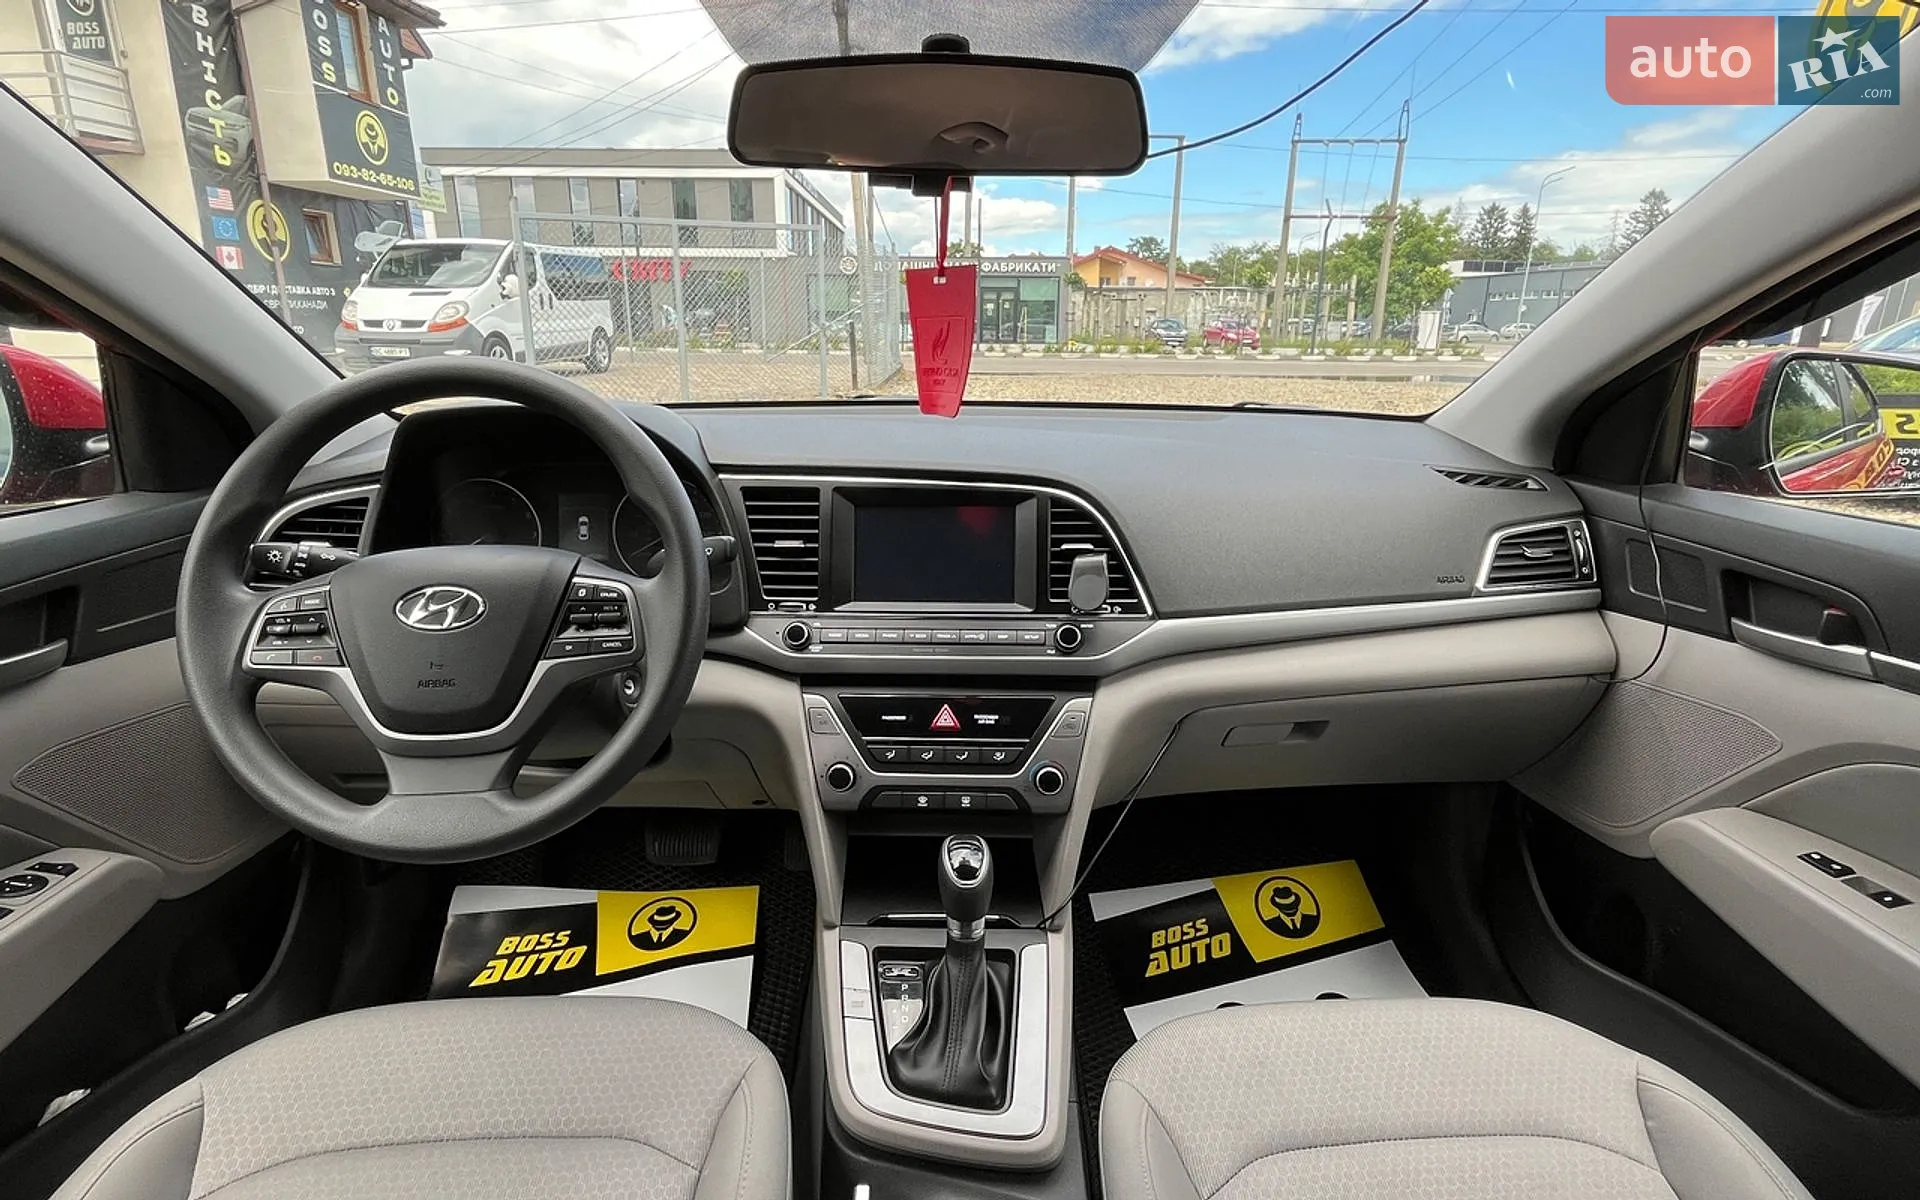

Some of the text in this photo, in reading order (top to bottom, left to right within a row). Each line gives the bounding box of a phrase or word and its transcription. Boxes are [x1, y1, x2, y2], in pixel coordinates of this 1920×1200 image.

[67, 22, 100, 35] BOSS
[312, 0, 337, 83] OSS
[376, 16, 399, 106] AUTO
[333, 161, 415, 191] 093-82-65-106
[417, 679, 457, 688] AIRBAG
[496, 930, 571, 955] BOSS
[1152, 918, 1209, 949] BOSS
[468, 945, 588, 988] AUTO
[1145, 932, 1231, 978] AUTO
